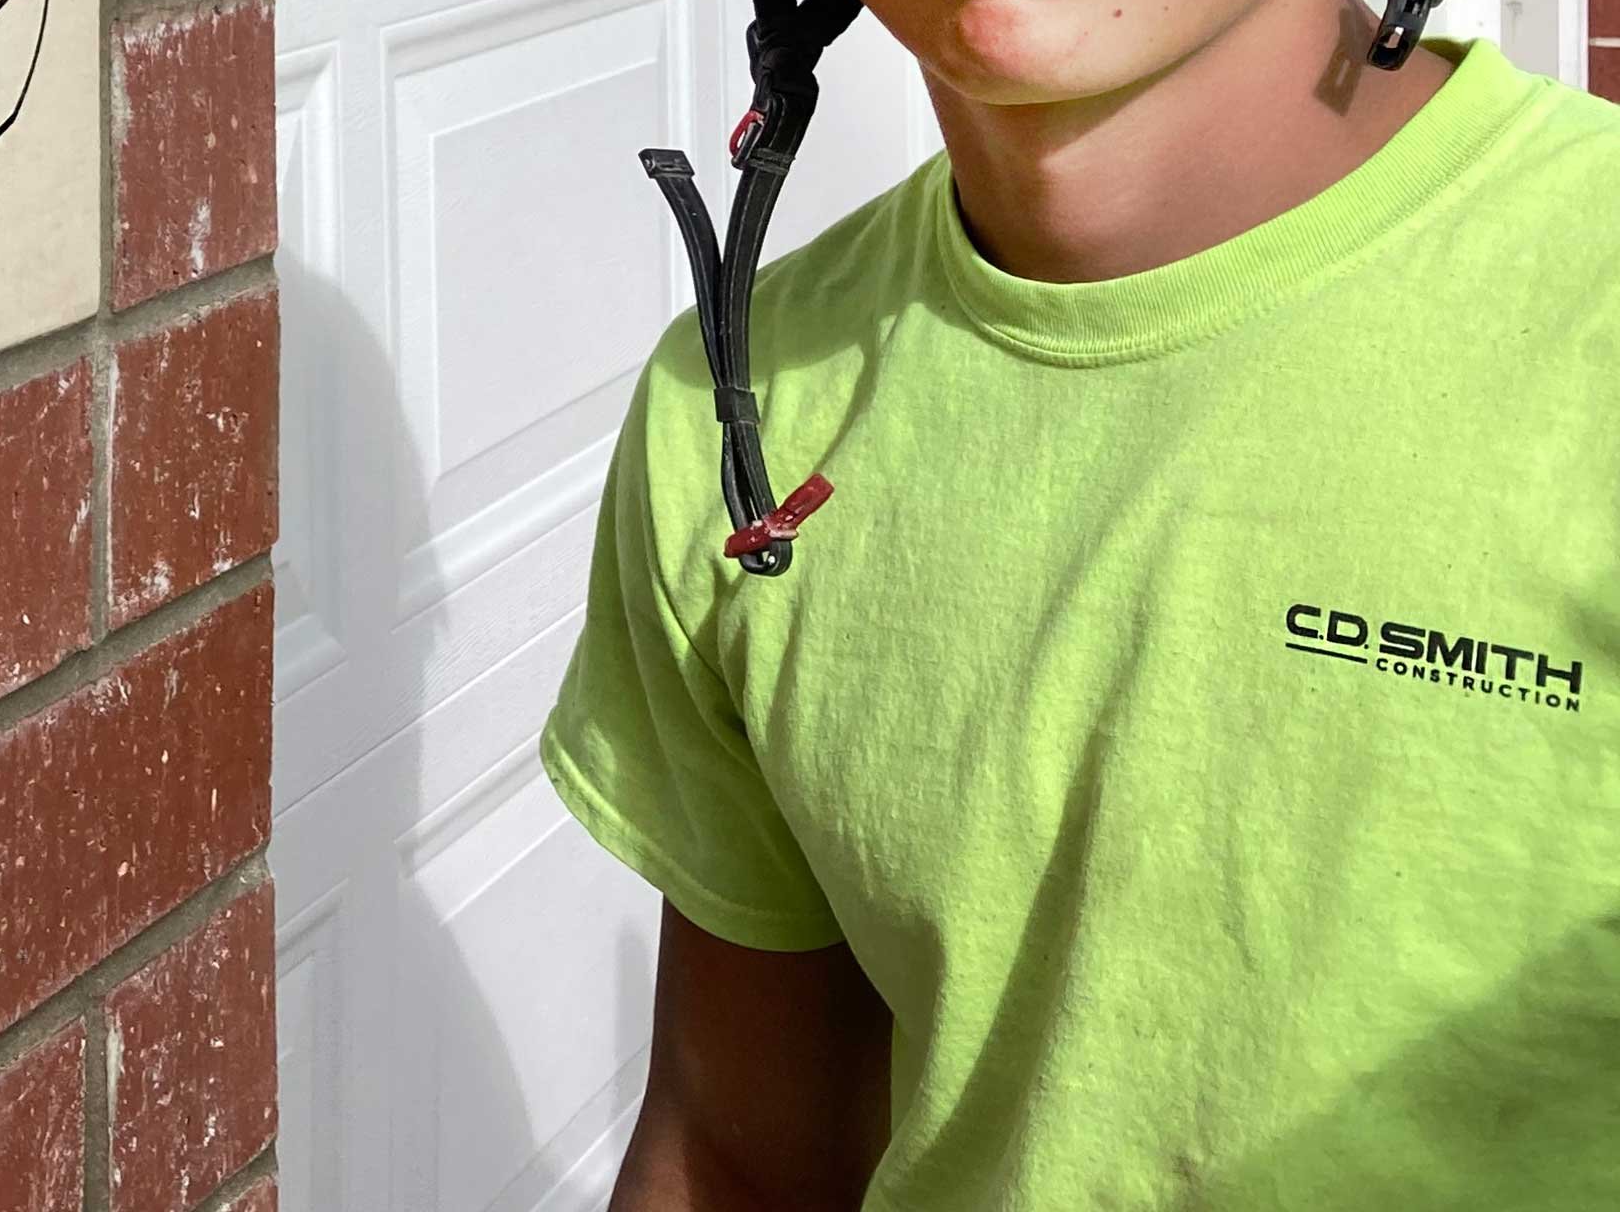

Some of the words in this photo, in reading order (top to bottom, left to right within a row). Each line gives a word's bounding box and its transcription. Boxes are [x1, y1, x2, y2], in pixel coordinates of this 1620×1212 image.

[1285, 603, 1369, 650] C.D.
[1378, 621, 1584, 695] SMITH
[1375, 657, 1581, 713] CONSTRUCTION
